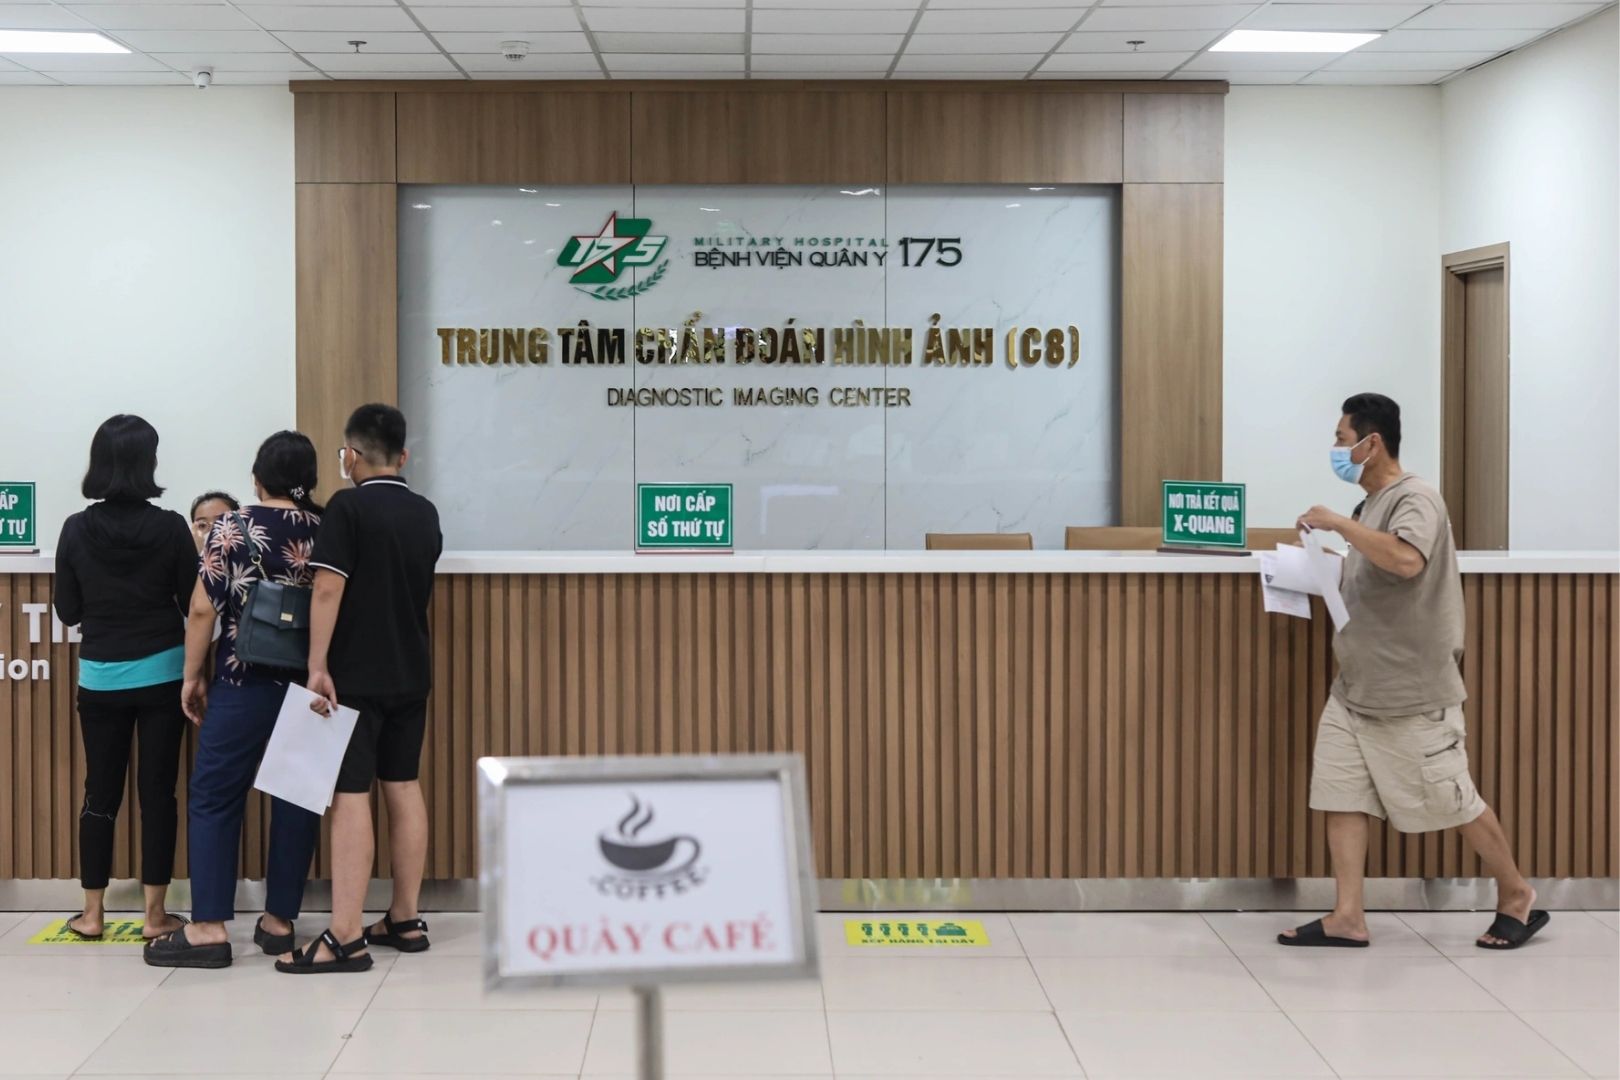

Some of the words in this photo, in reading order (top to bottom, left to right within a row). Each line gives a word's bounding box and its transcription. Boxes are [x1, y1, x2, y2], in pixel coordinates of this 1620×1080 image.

[694, 237, 784, 246] MILITARY
[794, 237, 889, 247] HOSPITAL
[695, 247, 751, 270] BỆNH
[756, 247, 803, 270] VIỆN
[809, 247, 868, 267] QUÂN
[872, 251, 888, 266] Y
[899, 237, 963, 267] 175
[437, 327, 549, 365] TRUNG
[557, 319, 626, 365] TÂM
[833, 318, 913, 365] HÌNH
[922, 312, 994, 365] ẢNH
[1005, 324, 1080, 369] (C8)
[607, 387, 723, 408] DIAGNOSTIC
[733, 387, 819, 408] IMAGING
[829, 387, 912, 408] CENTER
[654, 493, 682, 512] NƠI
[685, 490, 716, 512] CẤP
[1168, 492, 1185, 509] NƠI
[1185, 489, 1202, 510] TRẢ
[1203, 489, 1220, 511] KẾT
[1221, 490, 1240, 513] QUẢ
[7, 517, 28, 539] TỰ
[647, 515, 668, 538] SỐ
[671, 517, 702, 537] THỨ
[704, 519, 725, 541] TỰ
[1173, 514, 1235, 535] X-QUANG
[597, 871, 706, 900] COFFEE
[661, 911, 776, 954] CAFÉ
